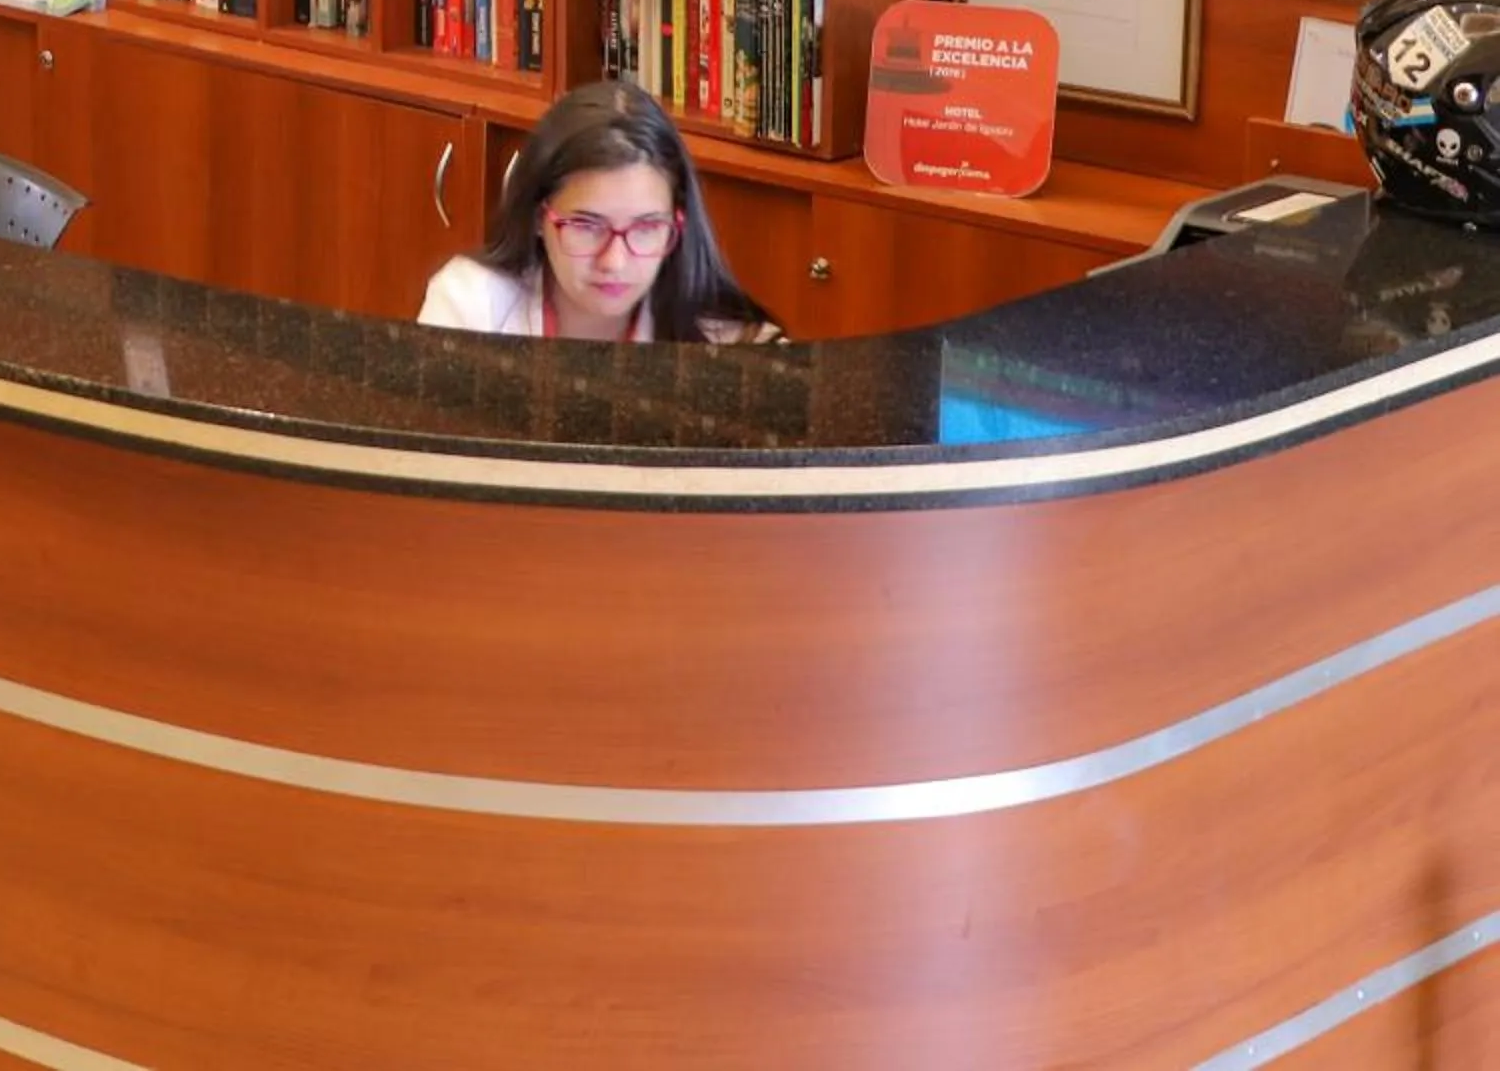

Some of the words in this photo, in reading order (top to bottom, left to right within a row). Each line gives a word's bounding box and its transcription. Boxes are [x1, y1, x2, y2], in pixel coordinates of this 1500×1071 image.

[934, 34, 994, 51] PREMIO
[996, 40, 1009, 53] A
[1012, 40, 1033, 56] LA
[931, 49, 1029, 70] EXCELENCIA
[1393, 38, 1431, 83] 12
[945, 105, 982, 120] HOTEL
